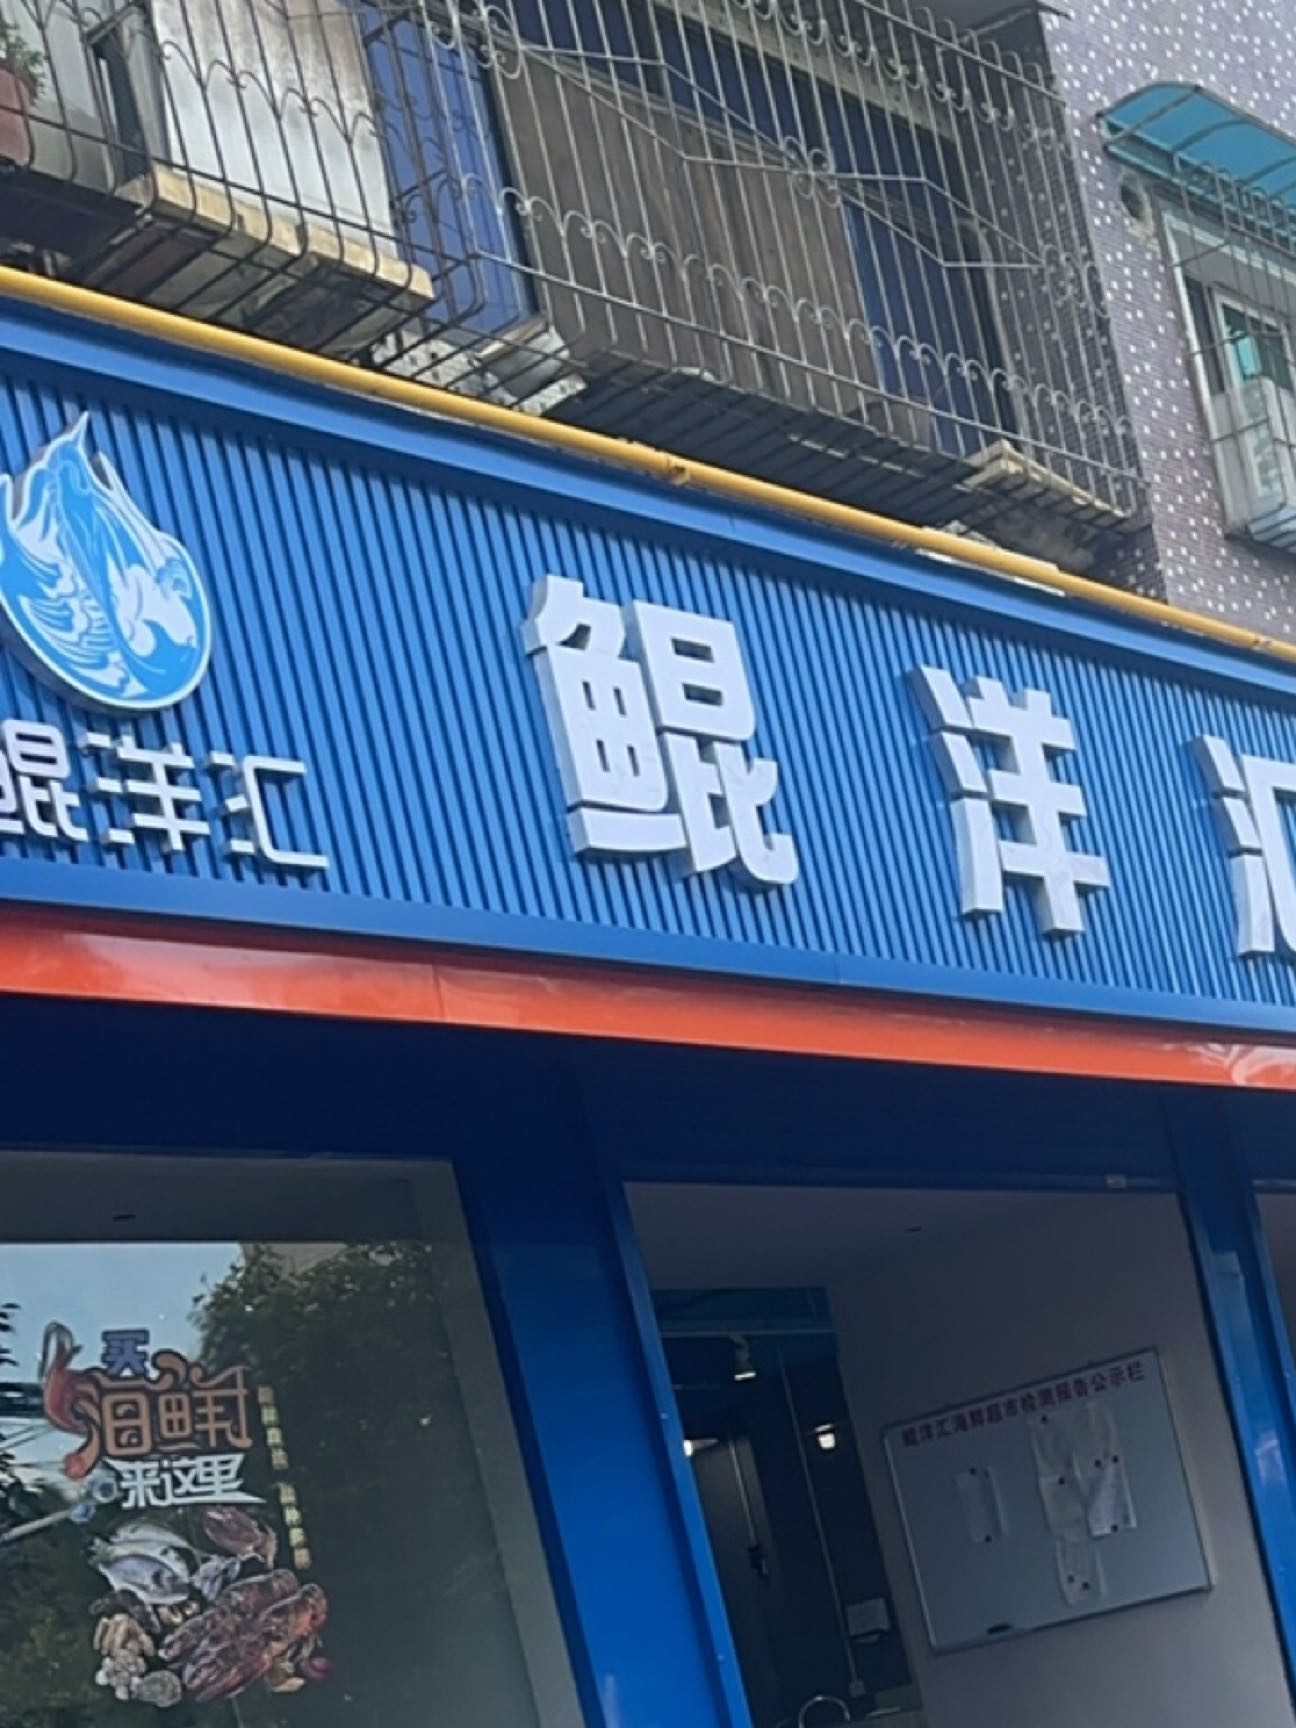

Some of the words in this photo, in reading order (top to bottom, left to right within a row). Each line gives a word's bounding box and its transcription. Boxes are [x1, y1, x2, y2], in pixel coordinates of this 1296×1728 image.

[101, 1328, 150, 1376] 买
[102, 1454, 266, 1508] 来这里
